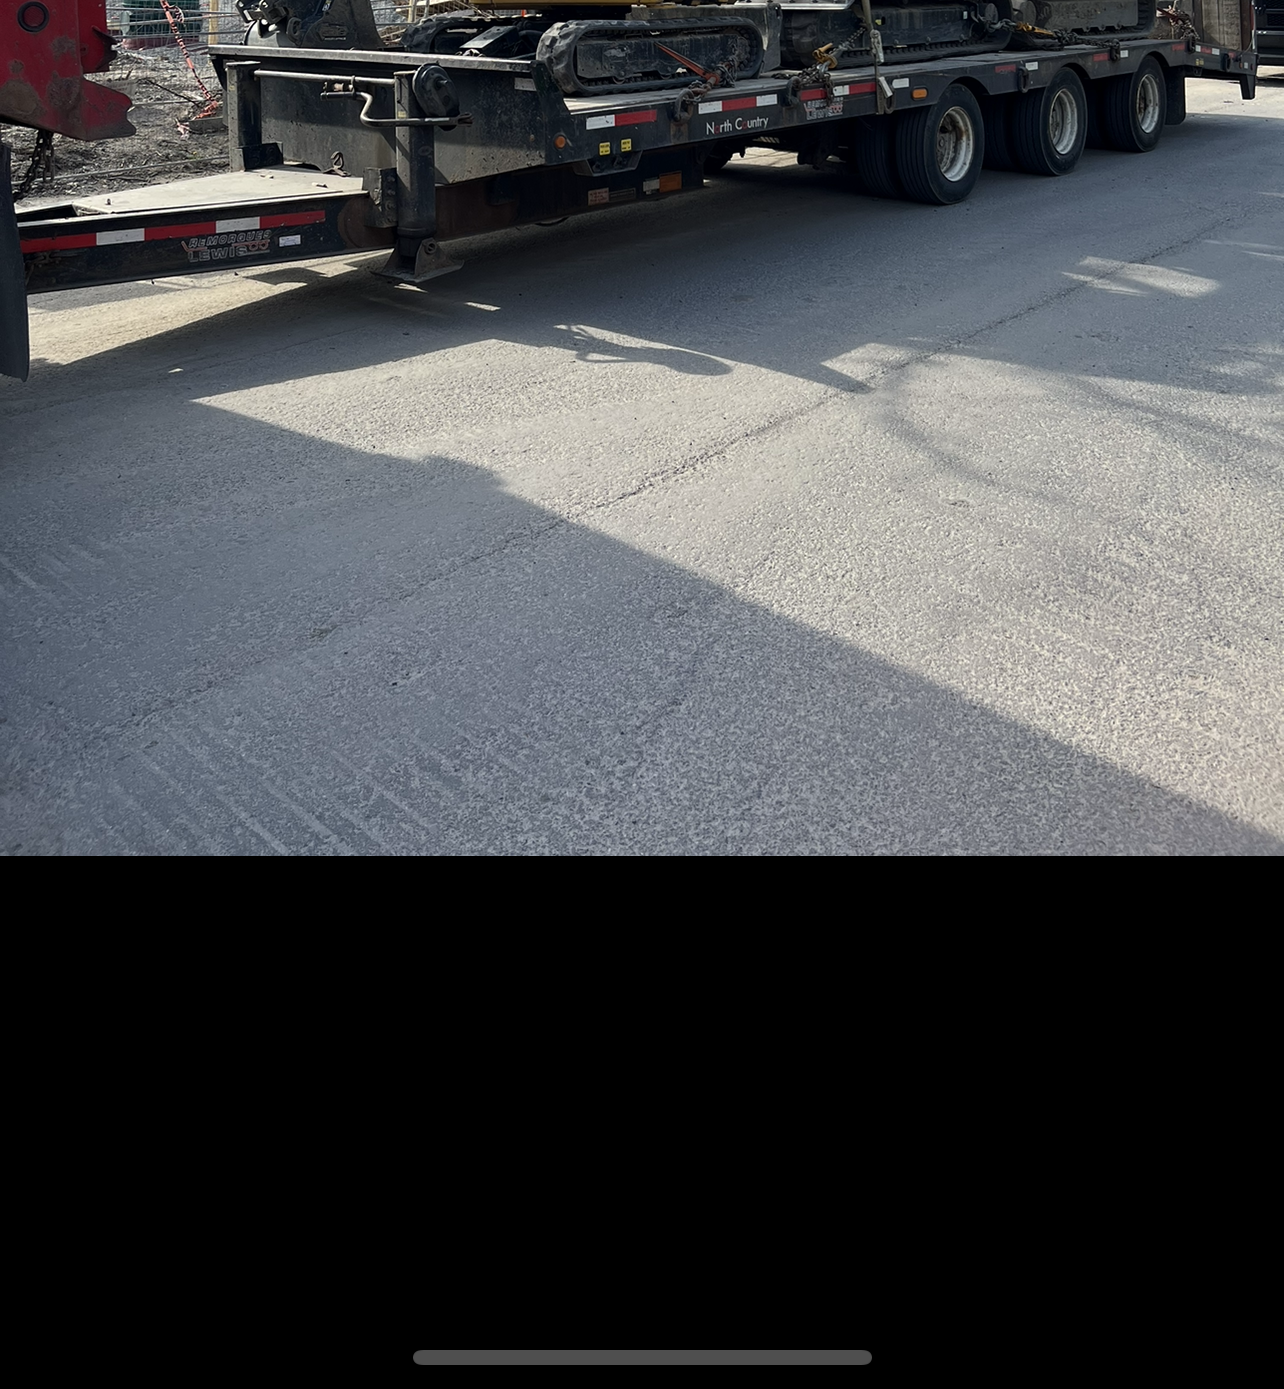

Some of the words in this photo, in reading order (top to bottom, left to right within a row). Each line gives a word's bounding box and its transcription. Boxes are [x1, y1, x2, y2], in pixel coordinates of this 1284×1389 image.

[706, 119, 733, 135] North
[734, 116, 769, 131] Country
[188, 230, 272, 248] REMORQUES
[188, 245, 248, 263] LEWIS
